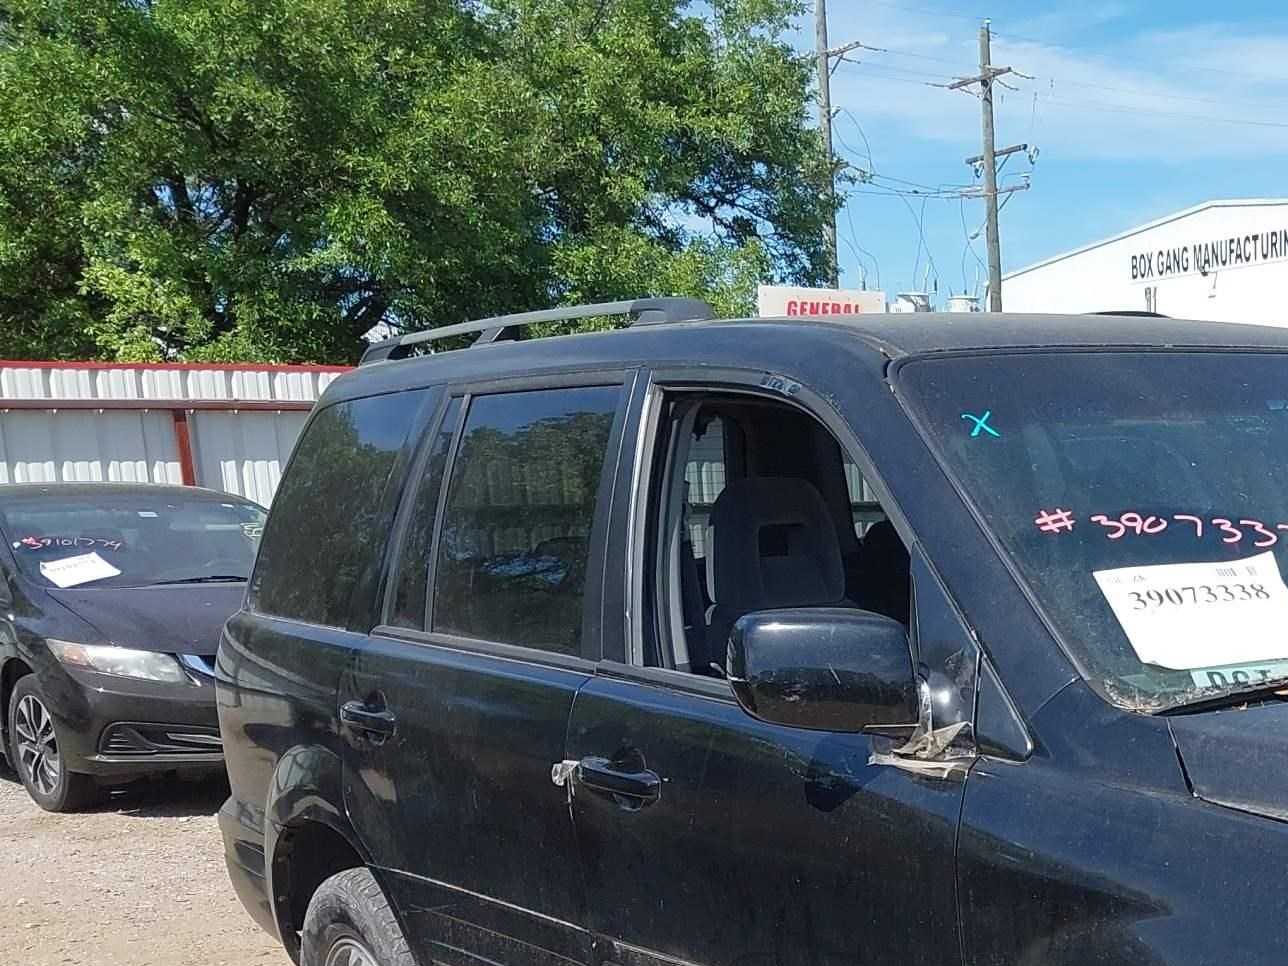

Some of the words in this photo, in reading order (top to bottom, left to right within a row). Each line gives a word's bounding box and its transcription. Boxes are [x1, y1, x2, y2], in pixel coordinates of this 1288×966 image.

[1131, 252, 1154, 279] BOX
[1157, 246, 1189, 276] GANG
[1128, 583, 1271, 610] 39073338
